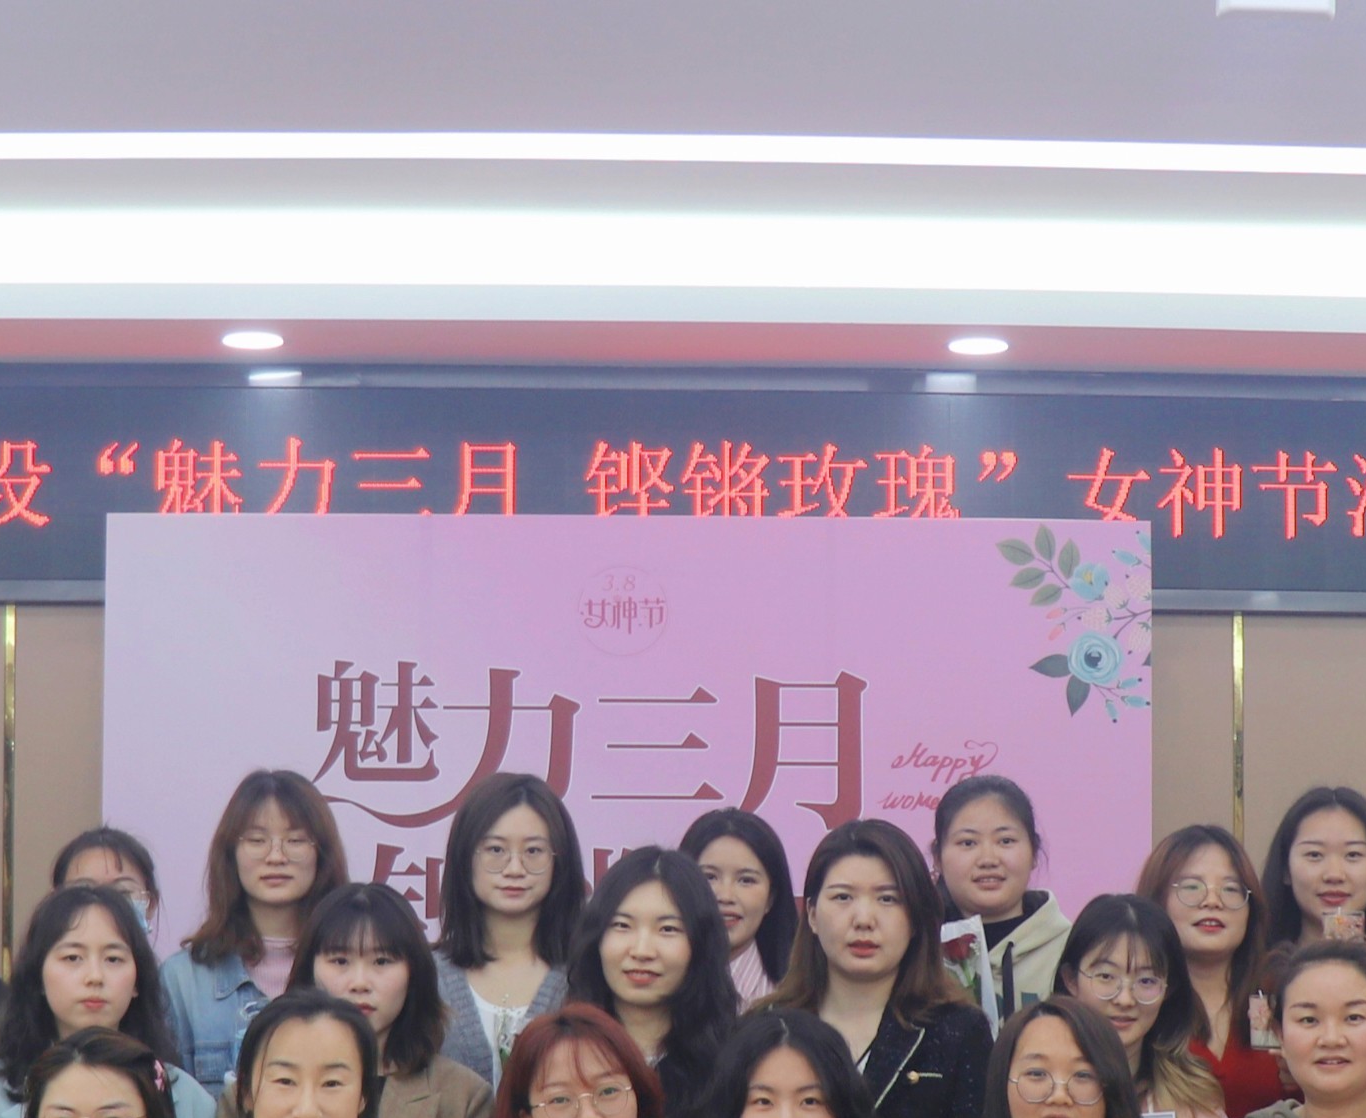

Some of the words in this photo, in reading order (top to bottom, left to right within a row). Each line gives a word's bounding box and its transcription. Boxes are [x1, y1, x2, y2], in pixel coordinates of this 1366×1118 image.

[602, 574, 636, 592] 3.8
[583, 596, 666, 635] 女神节
[310, 659, 868, 830] 魅力三月
[890, 741, 998, 784] Happy
